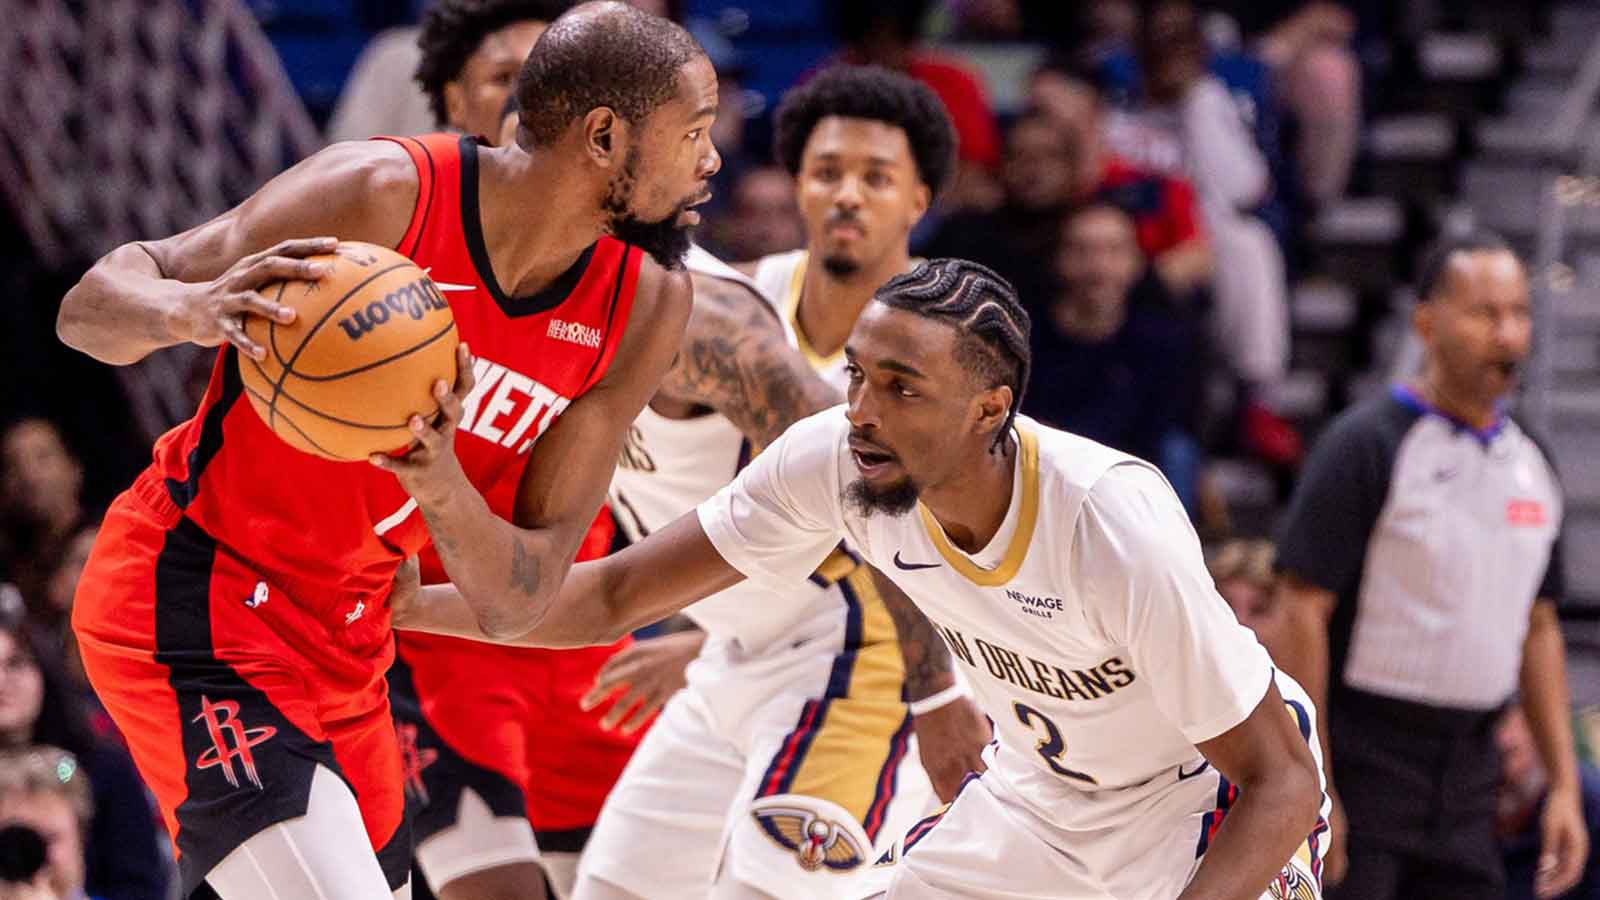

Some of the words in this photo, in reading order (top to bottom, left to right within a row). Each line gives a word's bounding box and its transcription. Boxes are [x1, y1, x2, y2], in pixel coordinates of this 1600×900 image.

[546, 326, 602, 348] HERMANN
[549, 319, 601, 338] MEMORIAL
[457, 355, 571, 455] KETS
[1006, 589, 1064, 611] NEWAGE
[1022, 606, 1052, 619] GRILLS
[974, 637, 1136, 700] ORLEANS
[1011, 700, 1099, 786] 2
